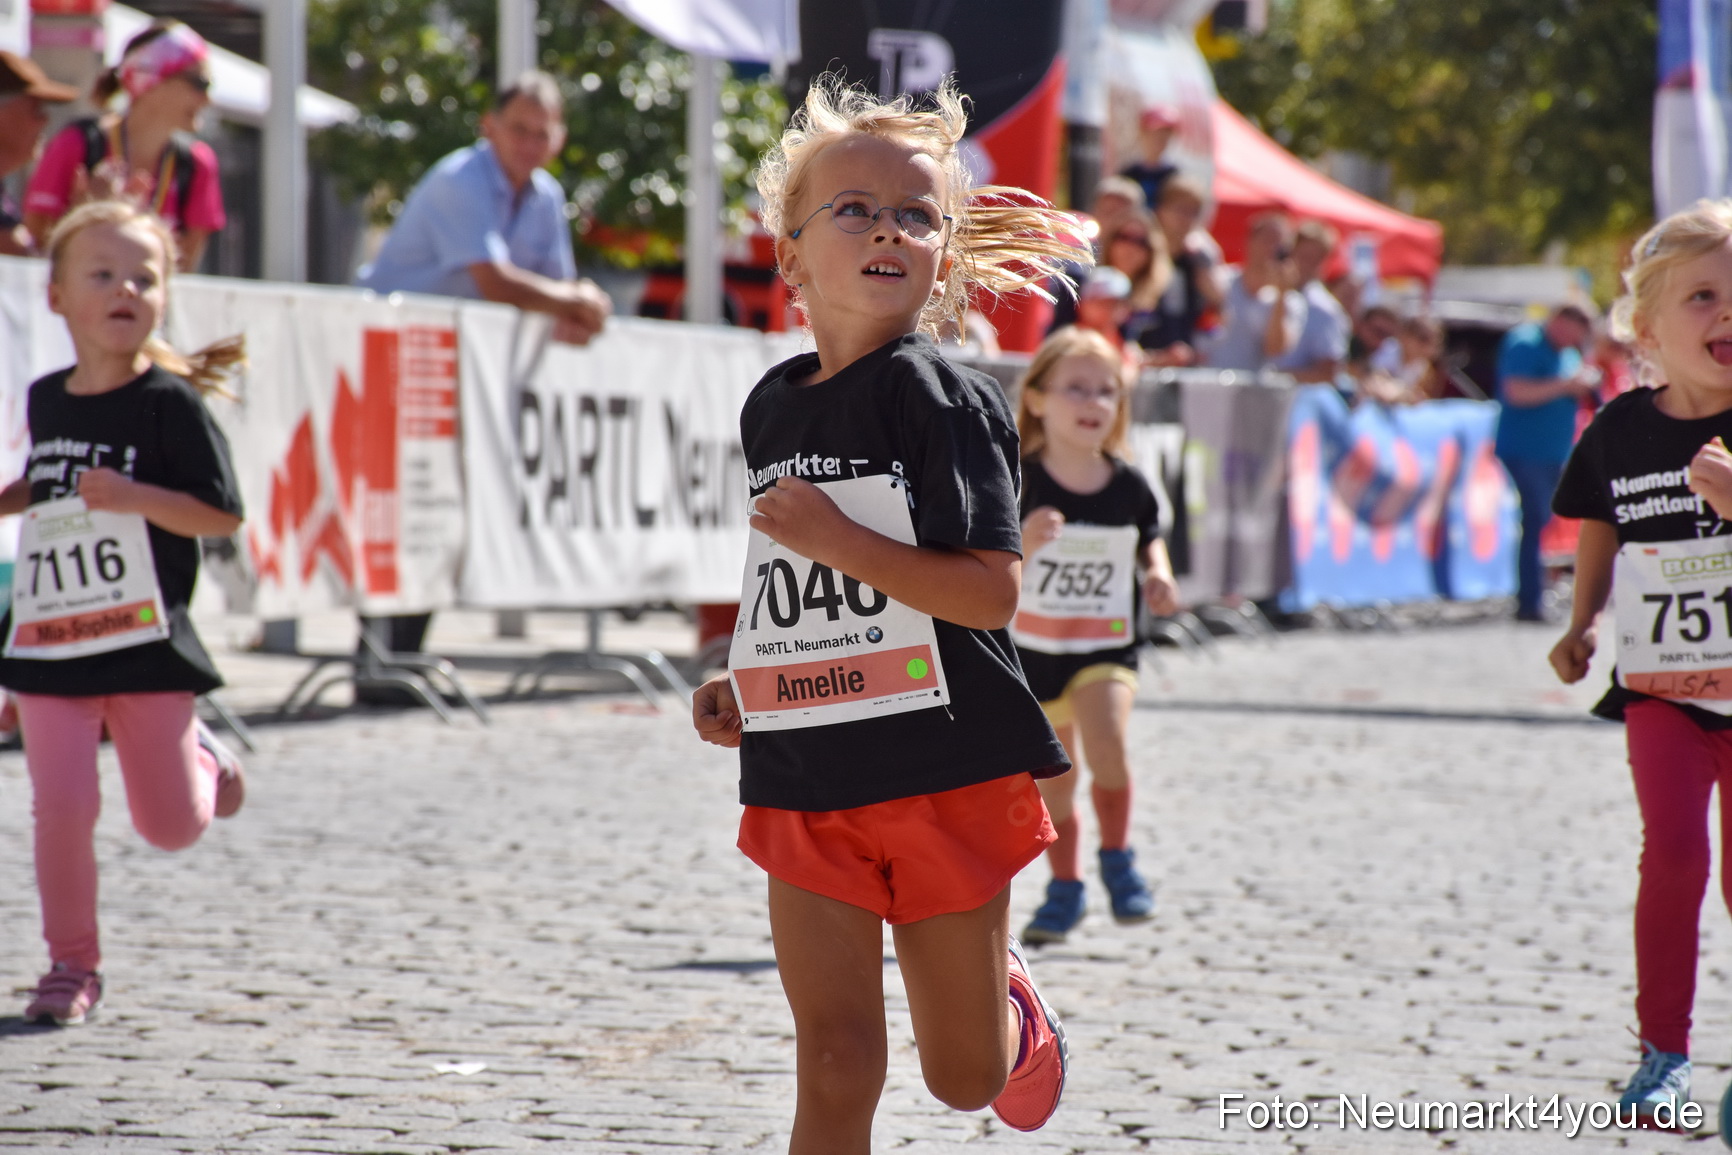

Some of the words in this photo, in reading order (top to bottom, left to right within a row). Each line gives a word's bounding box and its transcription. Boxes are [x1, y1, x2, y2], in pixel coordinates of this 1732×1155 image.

[519, 387, 656, 529] PARTL
[1615, 492, 1705, 524] Stadtlauf
[28, 537, 127, 598] 7116
[1037, 558, 1115, 597] 7552
[755, 641, 793, 656] PARTL
[794, 632, 861, 652] Neumarkt
[1659, 651, 1700, 664] PARTL
[777, 666, 866, 702] Amelie
[1648, 670, 1721, 698] LISA
